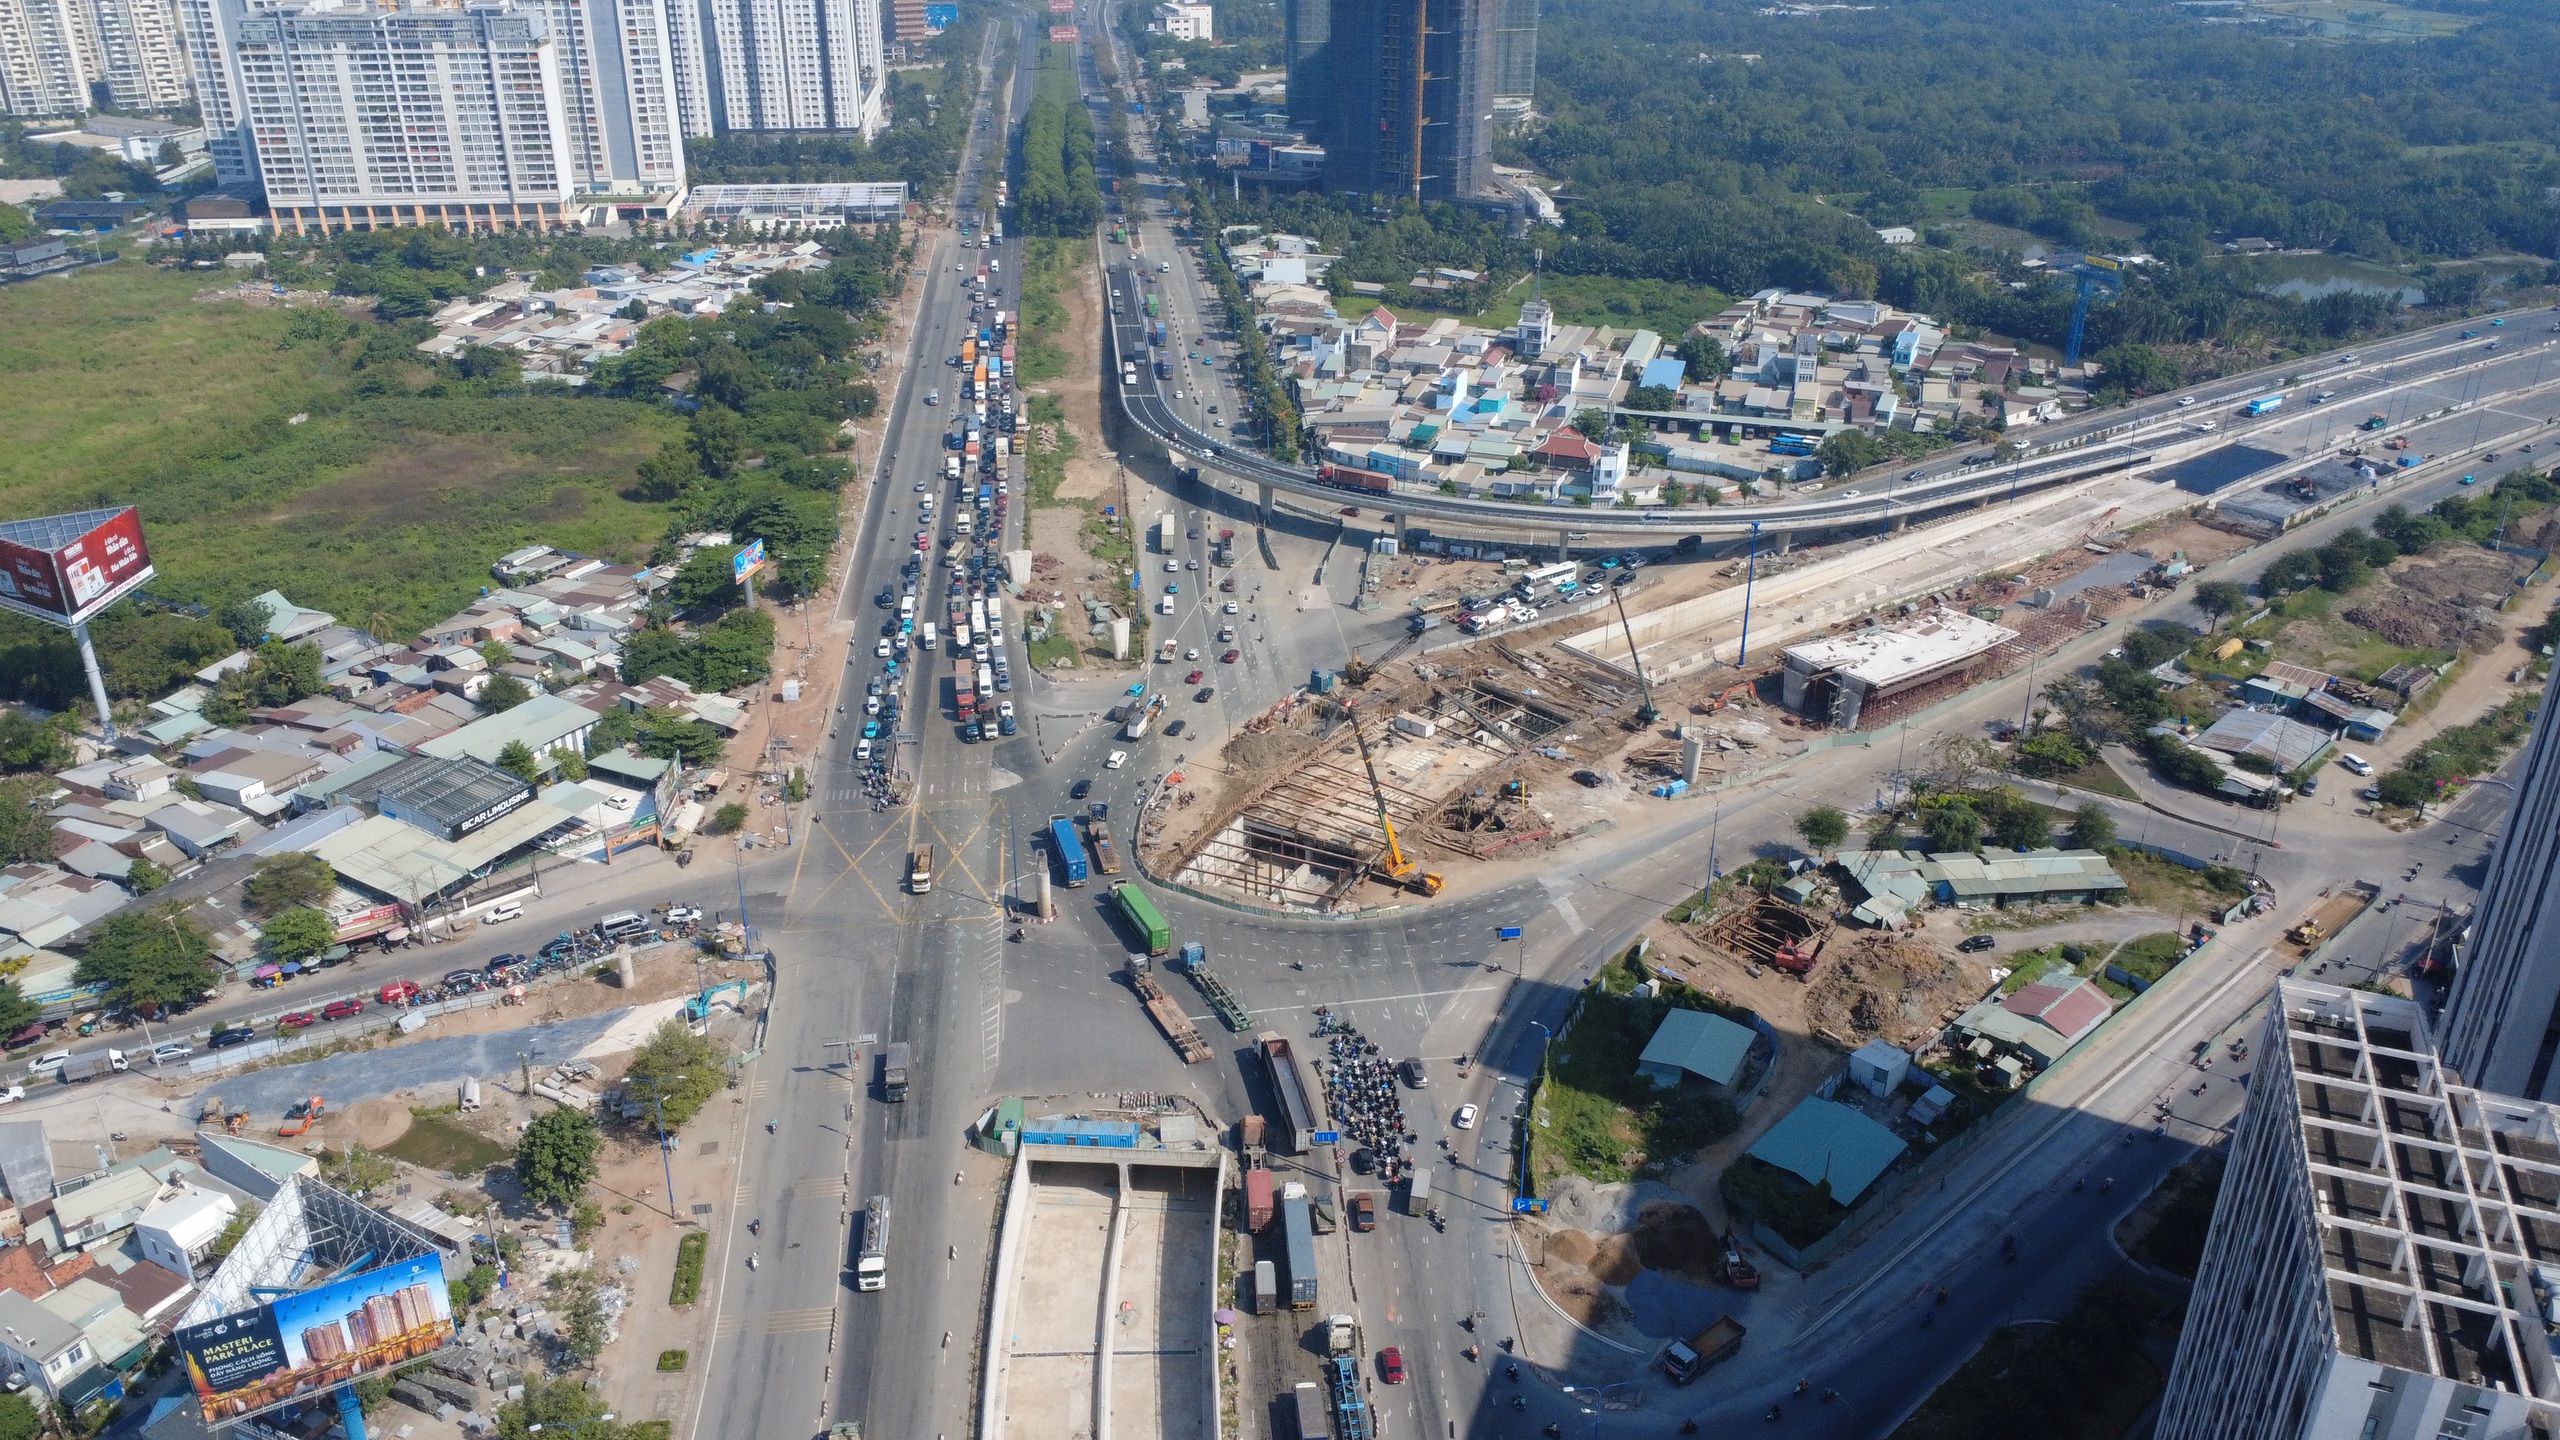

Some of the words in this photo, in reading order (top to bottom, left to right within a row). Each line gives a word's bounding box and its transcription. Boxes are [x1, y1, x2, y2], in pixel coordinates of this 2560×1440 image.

[461, 812, 487, 831] BCAR
[486, 789, 530, 818] LIMOUSINE
[203, 1336, 253, 1356] MASTERI
[205, 1351, 235, 1364] PARK
[237, 1338, 274, 1355] PLACE
[208, 1362, 235, 1374] PHONG
[235, 1355, 255, 1366] CÁCH
[256, 1349, 277, 1360] SỐNG
